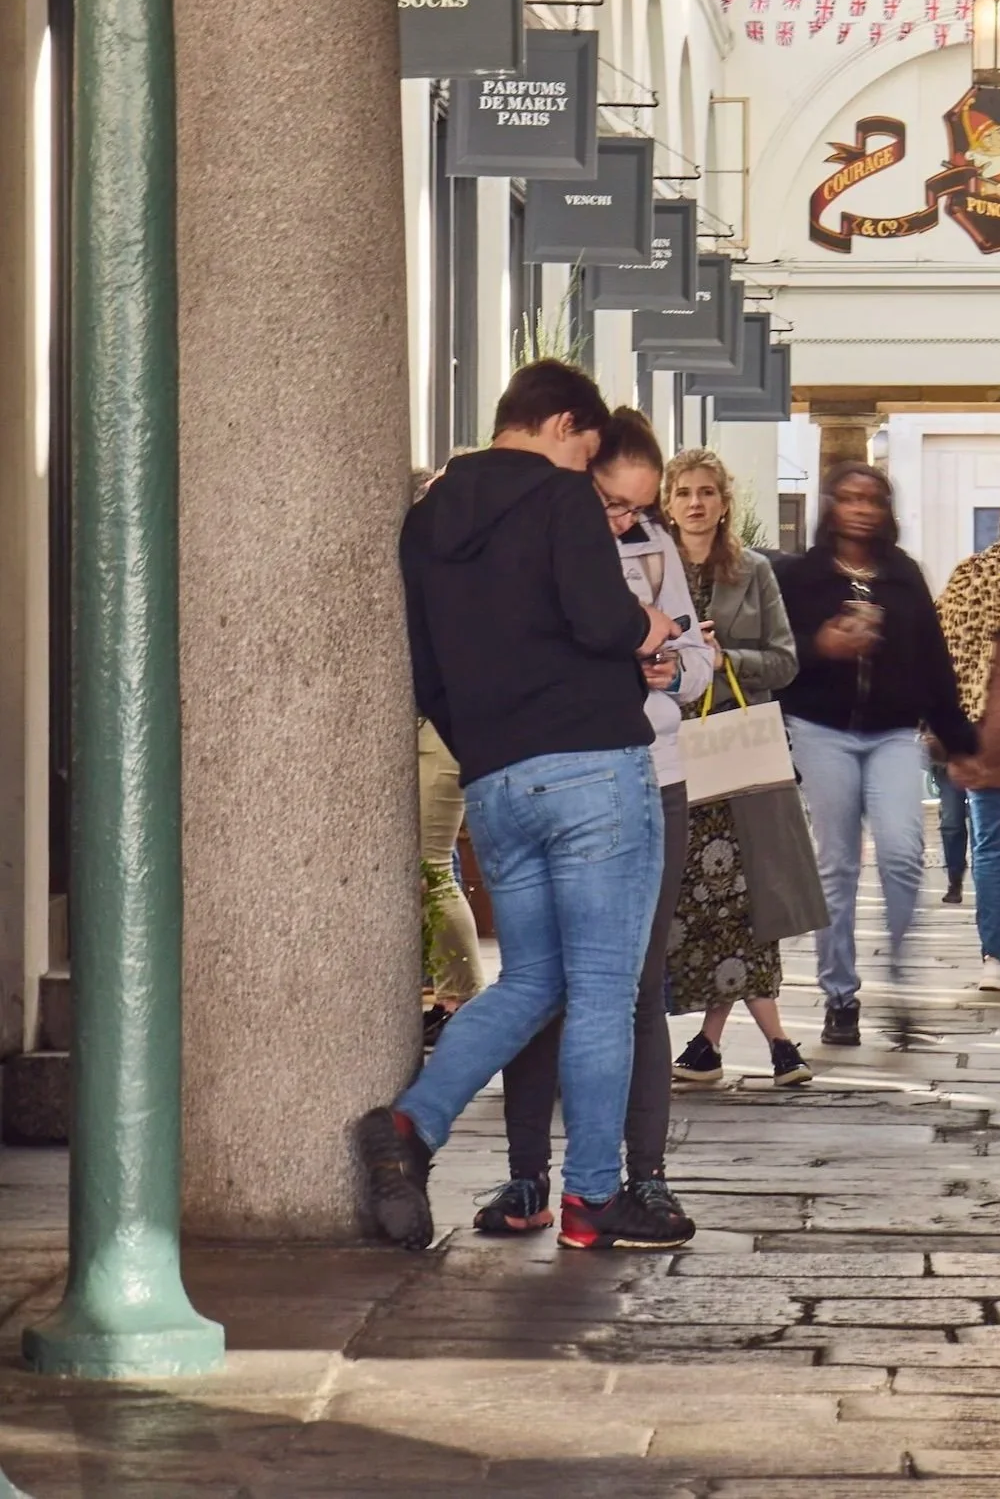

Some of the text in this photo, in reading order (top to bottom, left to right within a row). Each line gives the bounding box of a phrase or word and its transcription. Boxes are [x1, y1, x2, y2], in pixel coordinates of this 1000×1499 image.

[482, 80, 566, 96] PARFUMS
[479, 95, 568, 111] DE MARLY
[497, 111, 550, 126] PARIS
[823, 146, 894, 200] COURAGE
[564, 195, 612, 206] VENCHI
